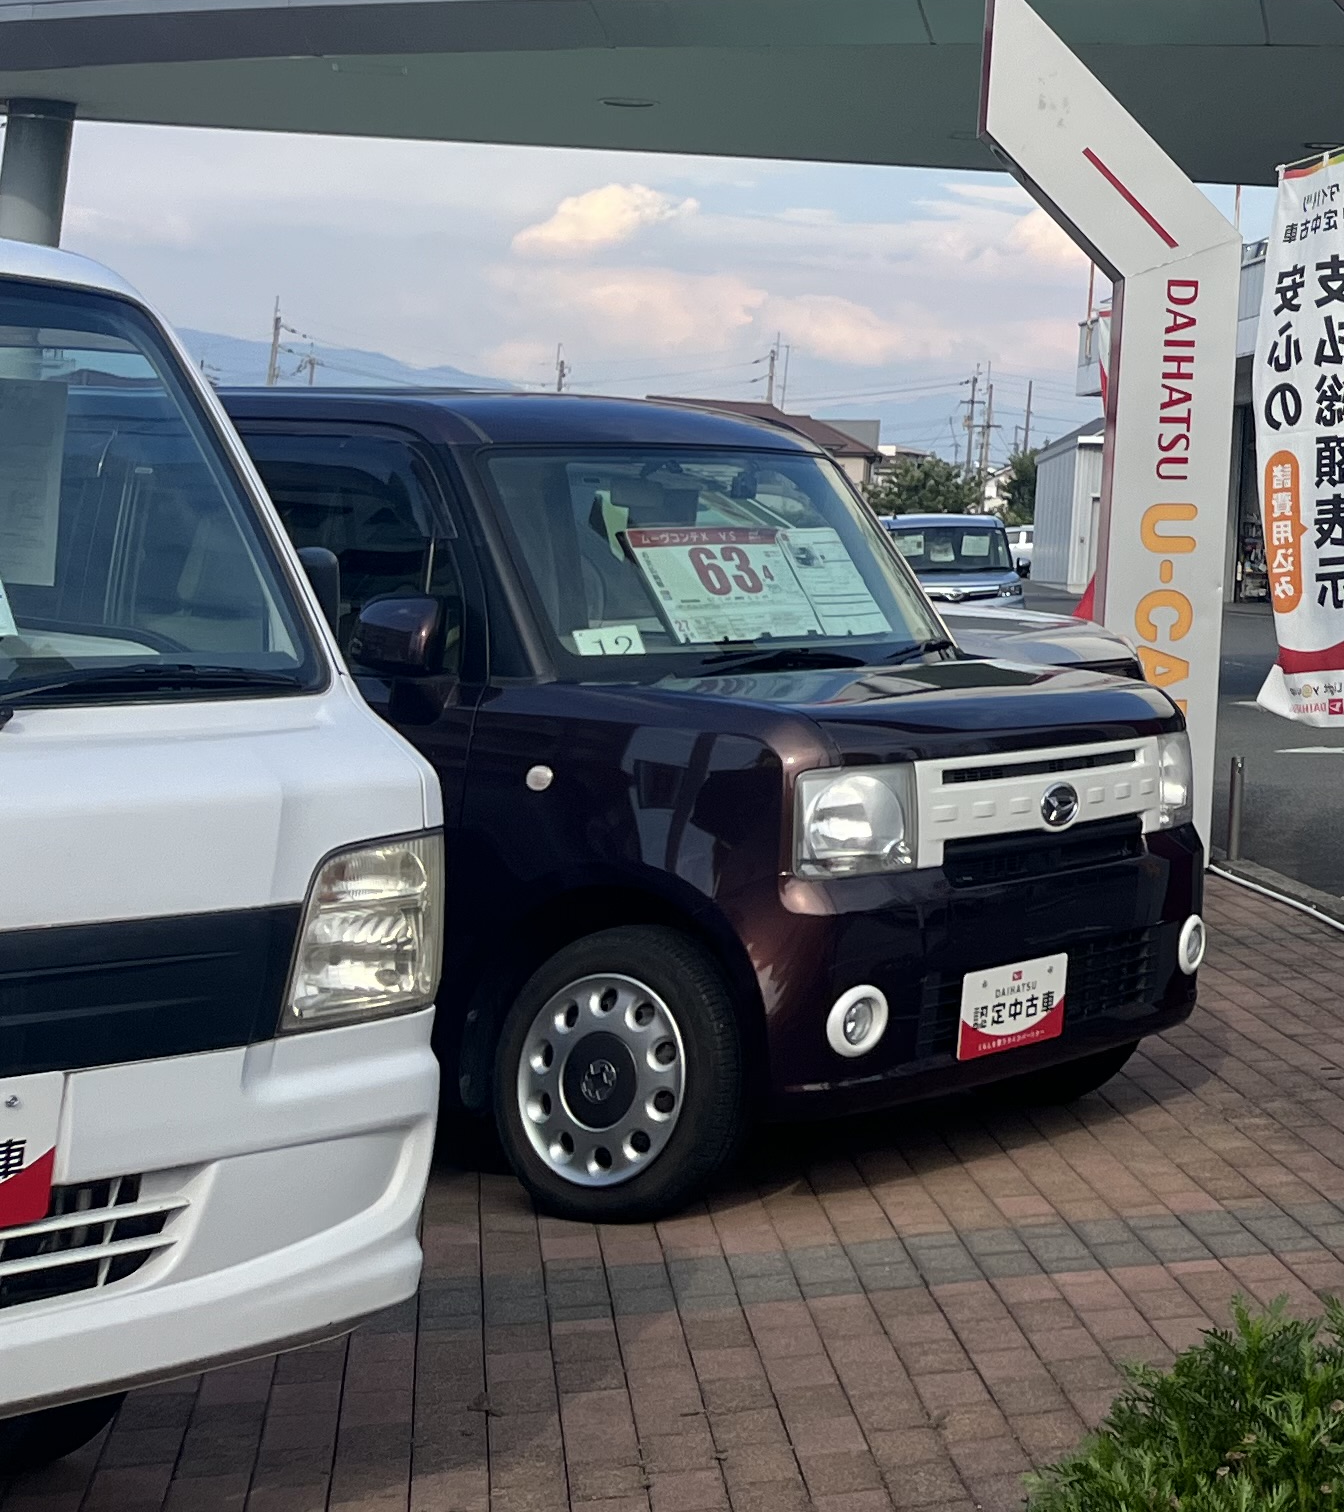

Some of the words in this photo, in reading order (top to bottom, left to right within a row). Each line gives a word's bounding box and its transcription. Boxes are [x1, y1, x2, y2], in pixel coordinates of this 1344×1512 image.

[1157, 278, 1199, 482] DAIHATSU
[1134, 503, 1199, 718] U-CA
[973, 991, 1055, 1029] 認定中古車
[995, 980, 1037, 999] DAIHATSU
